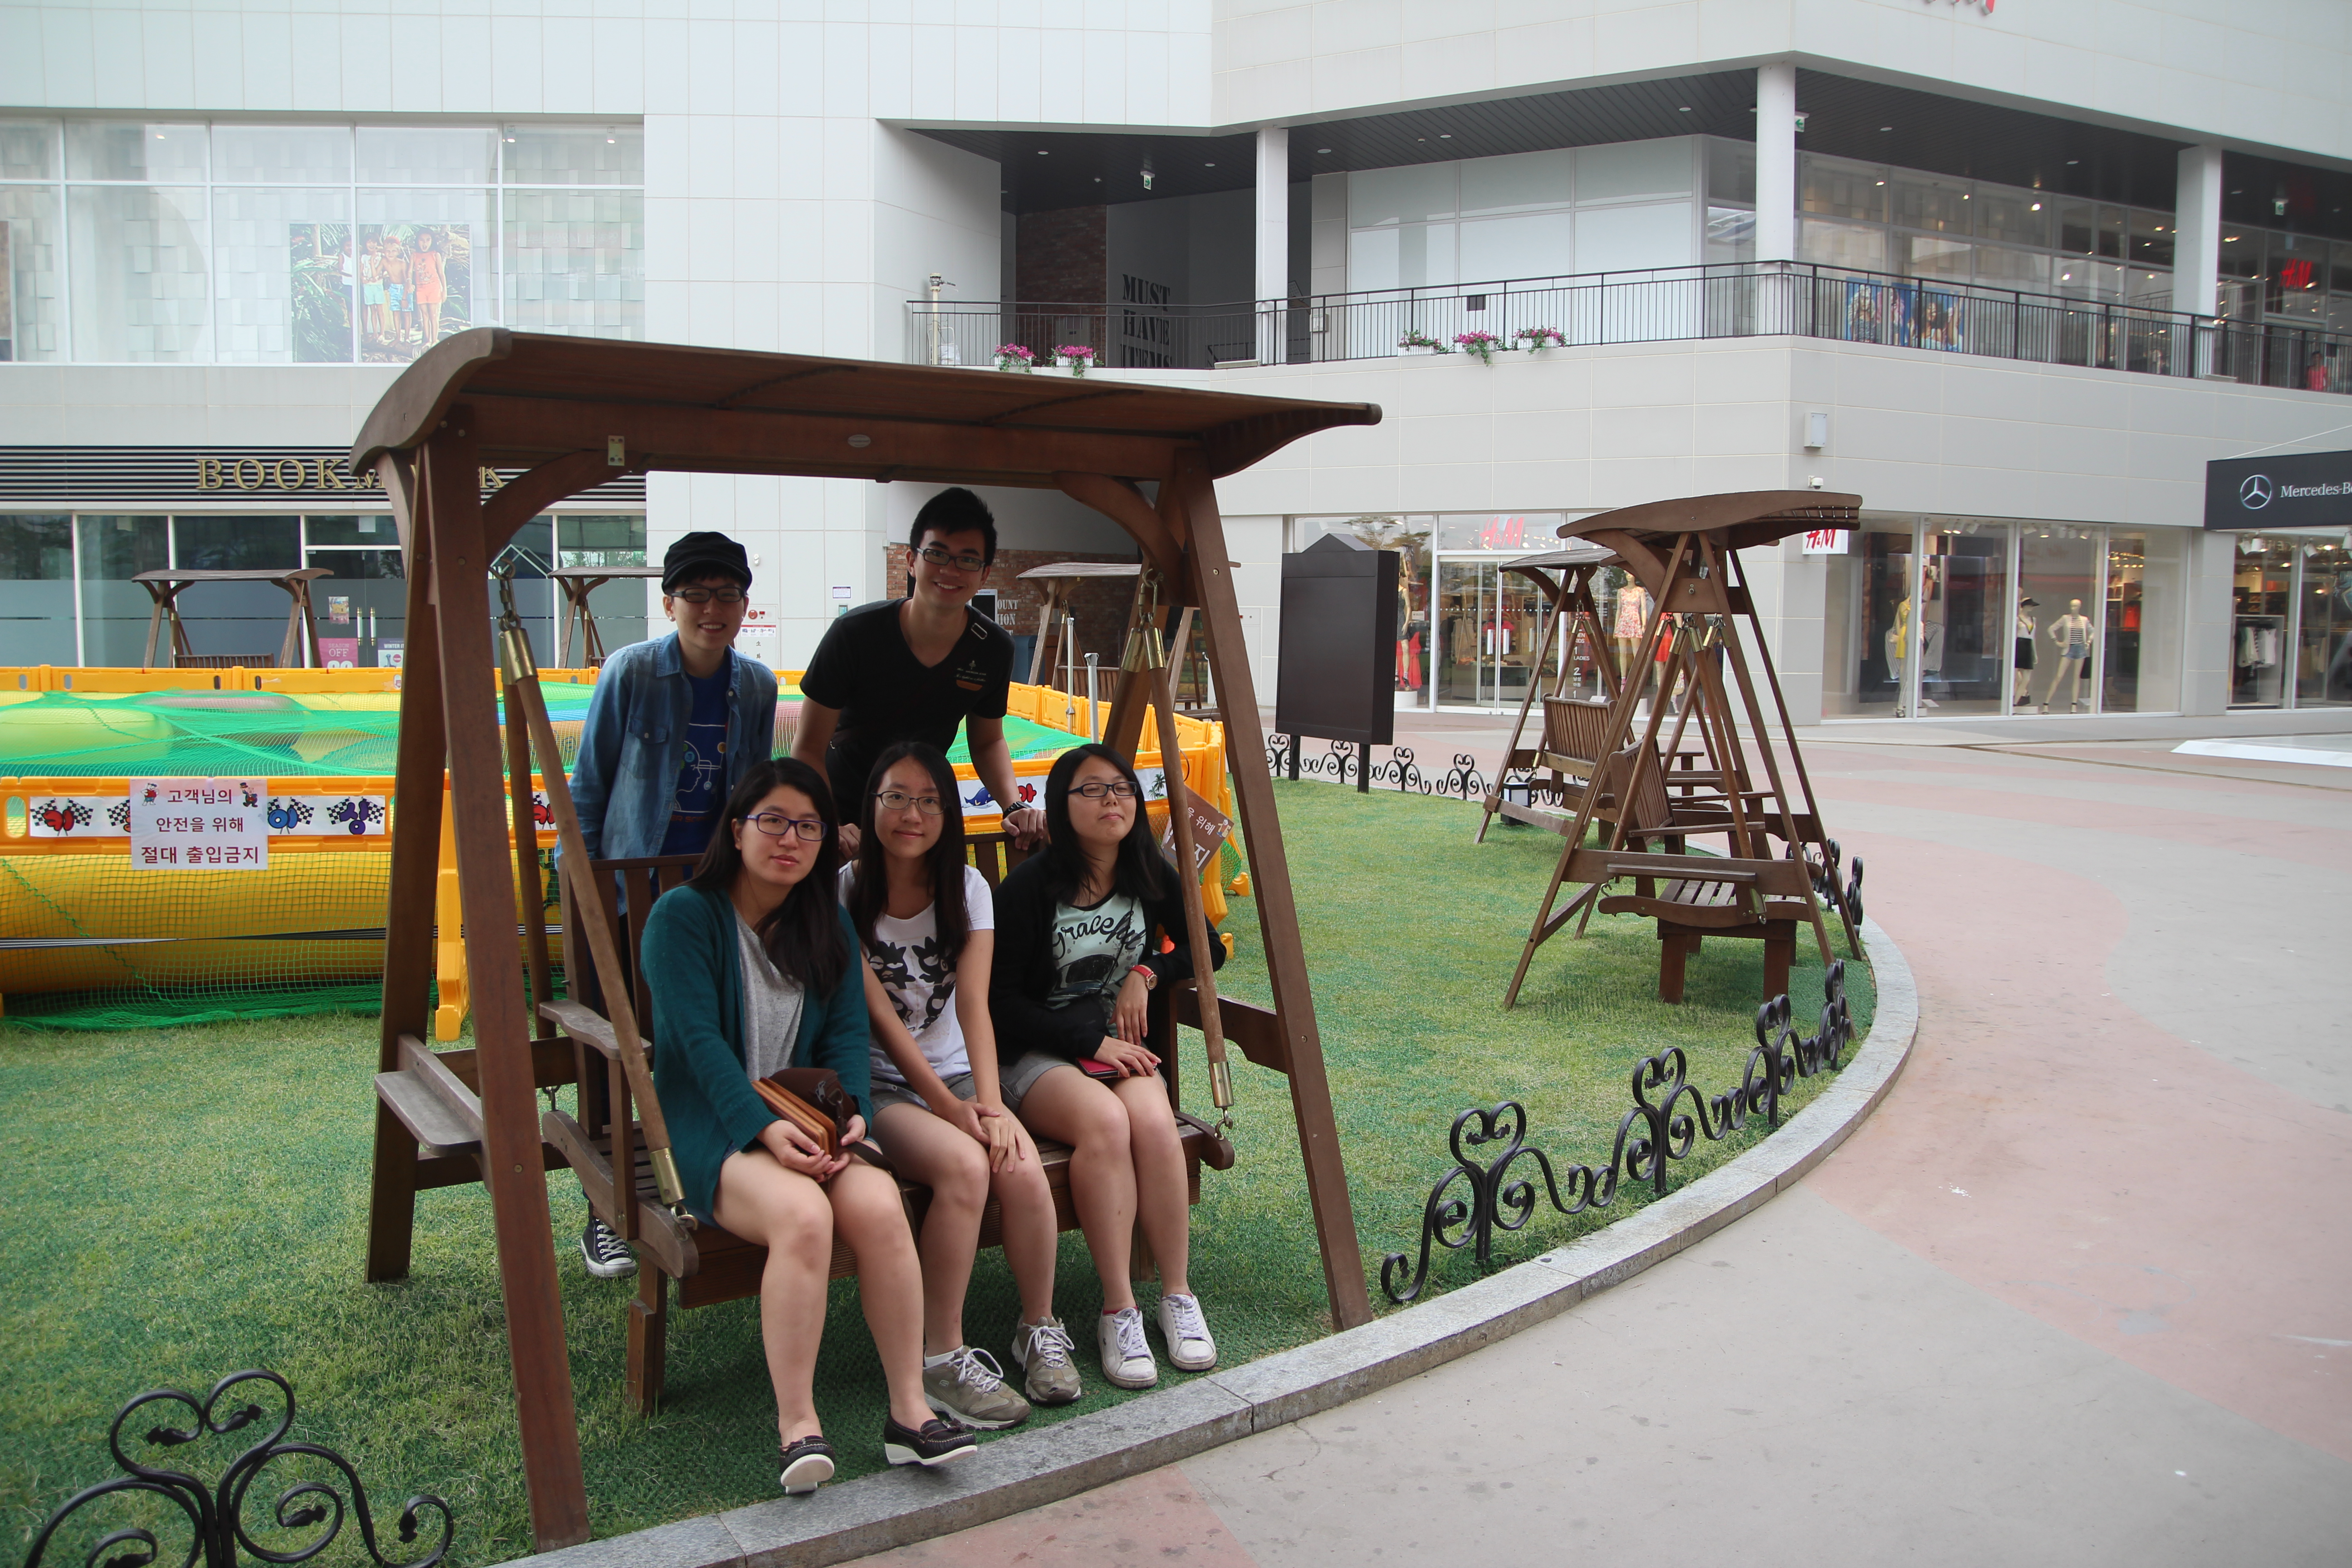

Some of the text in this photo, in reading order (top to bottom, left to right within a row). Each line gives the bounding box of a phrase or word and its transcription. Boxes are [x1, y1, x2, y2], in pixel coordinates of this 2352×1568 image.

[1122, 274, 1170, 312] MUST
[1123, 309, 1169, 346] HAVE
[1479, 516, 1524, 548] H&M
[1806, 529, 1836, 549] H&M
[1574, 646, 1578, 655] 1
[1573, 667, 1581, 676] 2
[1573, 690, 1576, 699] 1
[167, 789, 232, 804] 고객님의
[156, 817, 243, 833] 안전을 위해
[1196, 816, 1215, 836] 위해
[141, 846, 258, 864] 절대 출입금지
